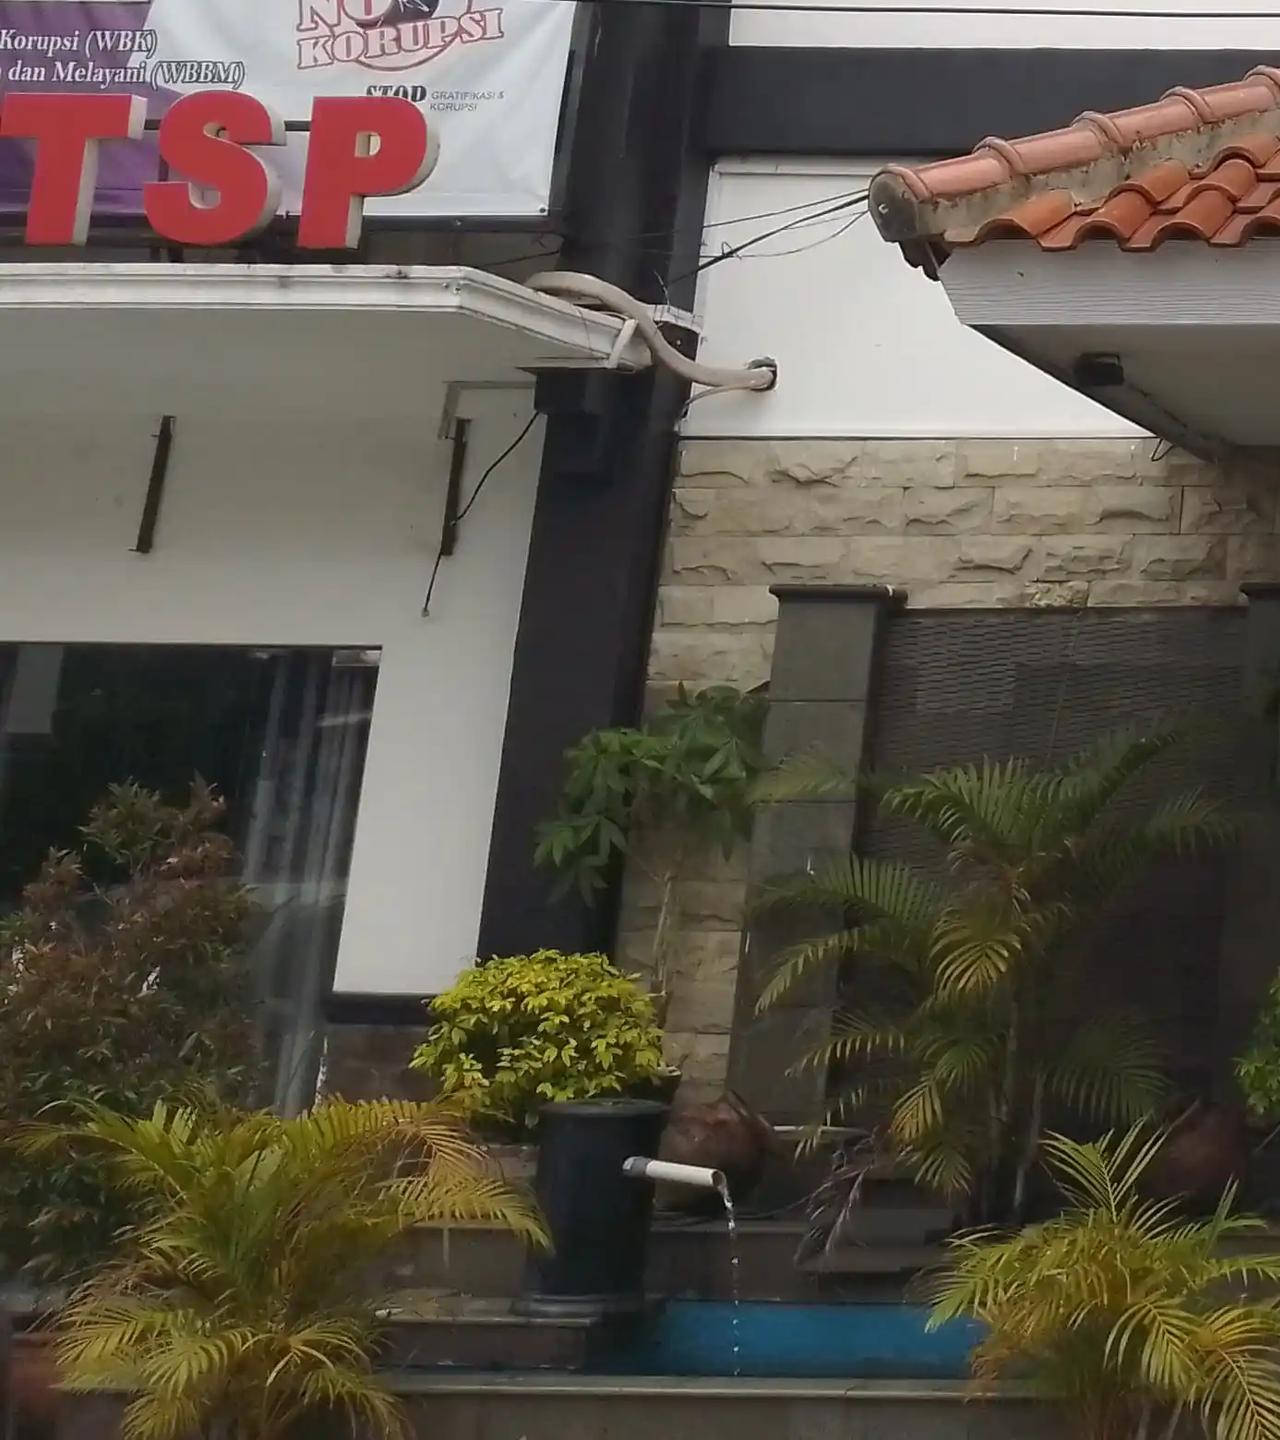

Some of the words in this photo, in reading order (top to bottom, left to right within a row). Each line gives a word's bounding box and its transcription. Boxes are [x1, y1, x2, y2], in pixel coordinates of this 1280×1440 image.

[0, 29, 80, 58] Korupsi
[85, 28, 159, 59] (WBK)
[297, 7, 504, 70] KORUPSI
[8, 60, 46, 82] dan
[51, 61, 146, 89] Melayani
[150, 59, 246, 91] (WBBM)
[430, 102, 478, 112] KORUPSI
[431, 90, 495, 101] GRATIFIKASI
